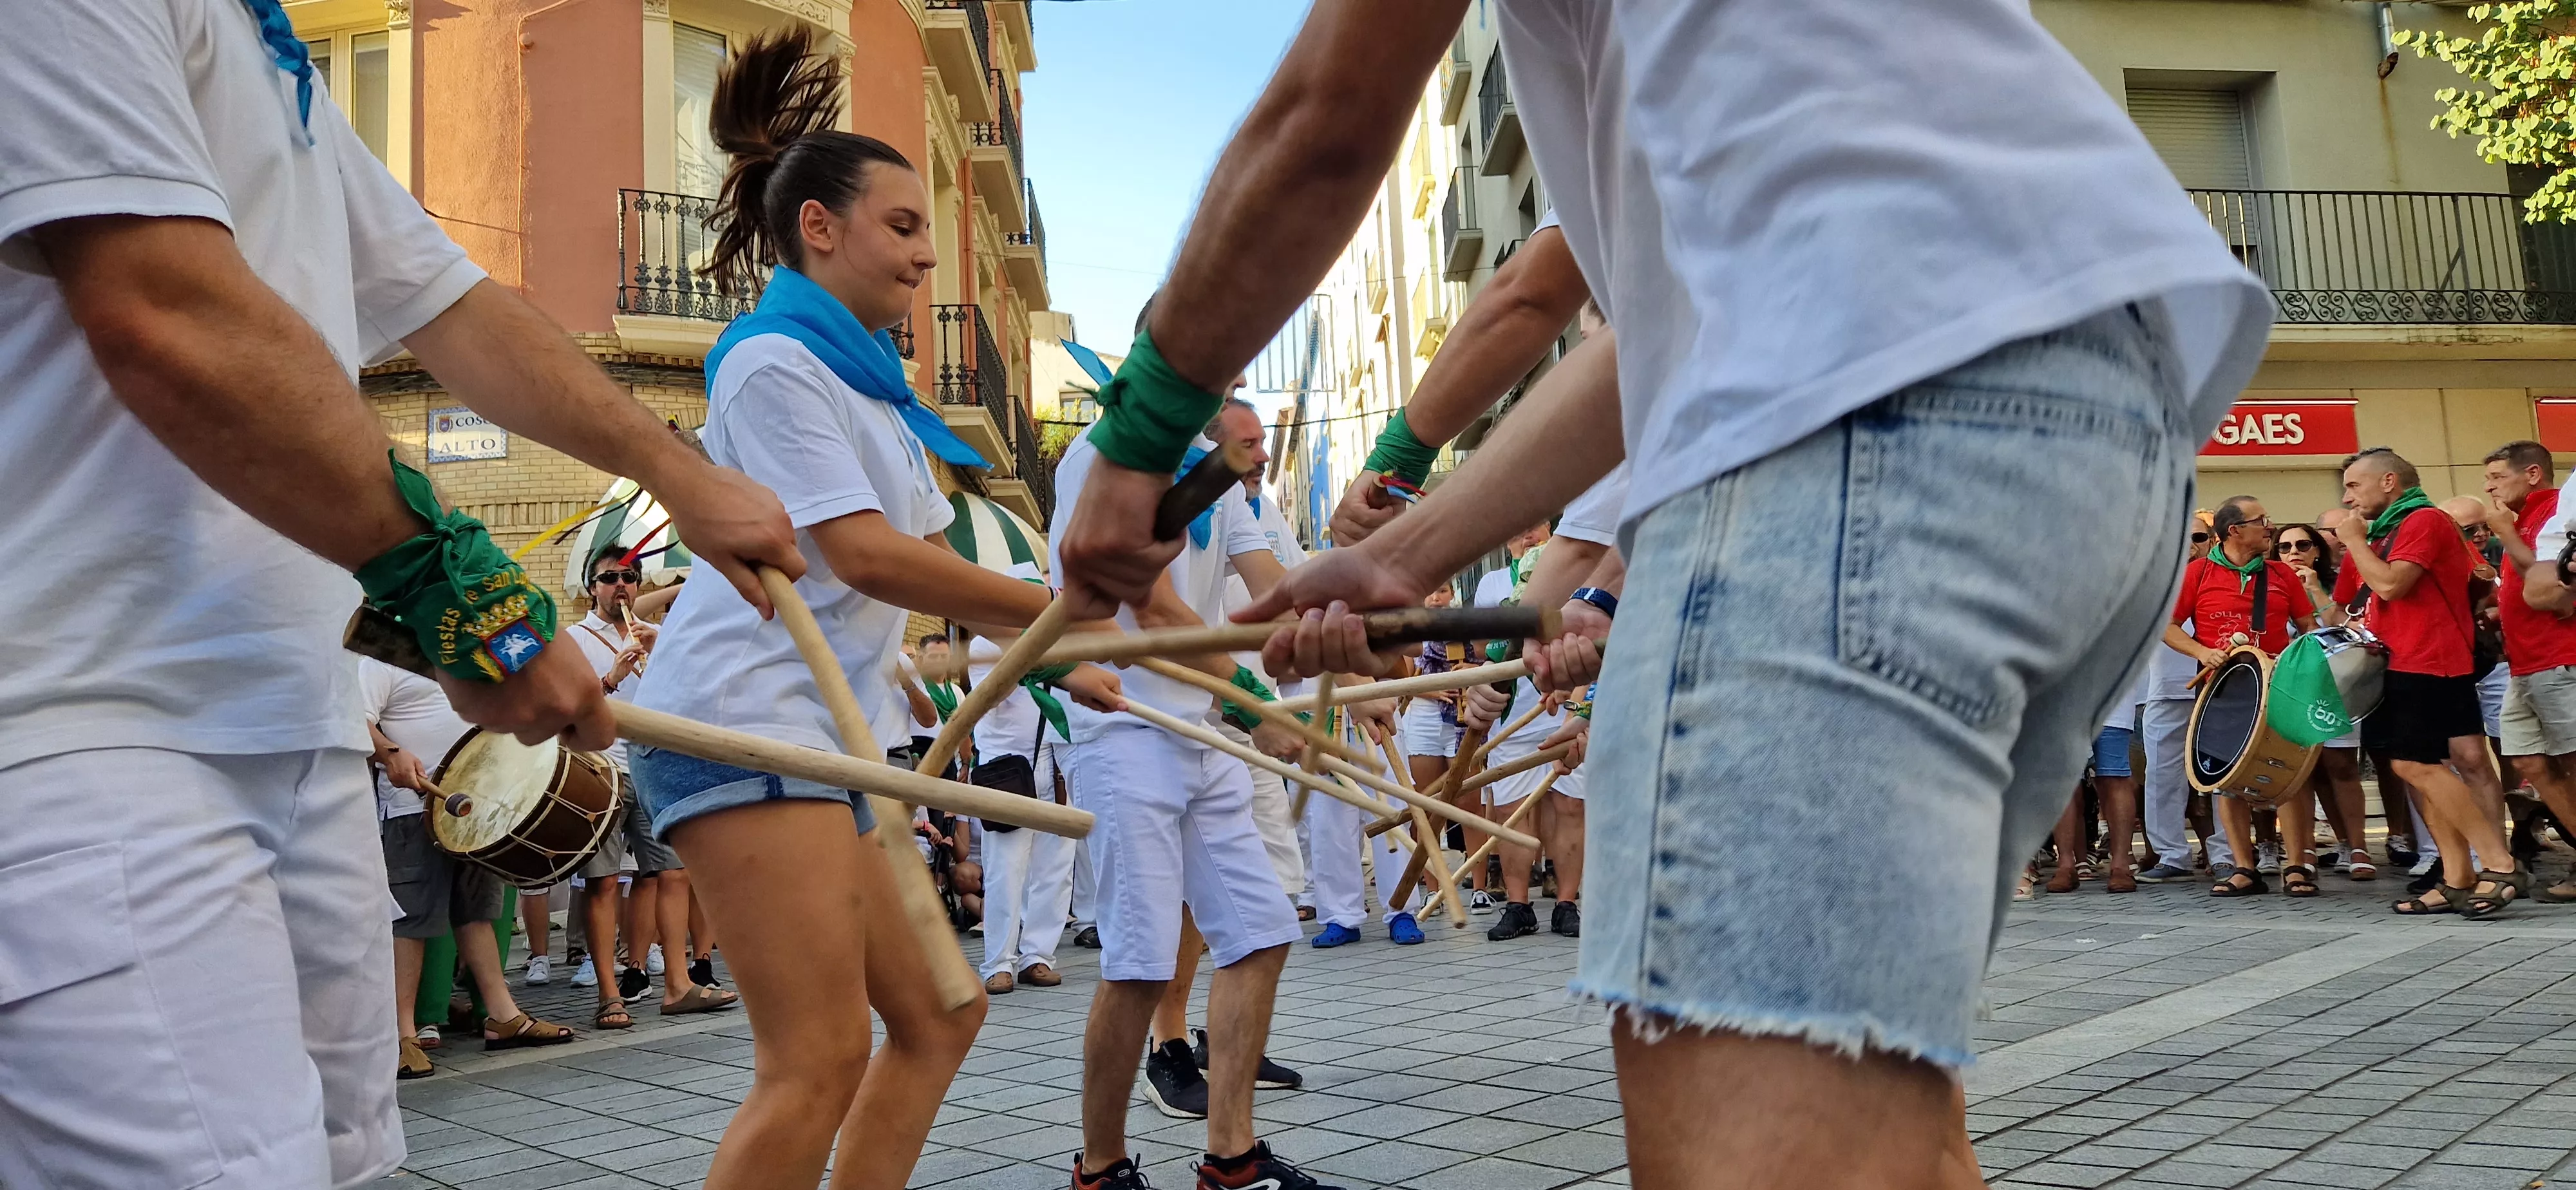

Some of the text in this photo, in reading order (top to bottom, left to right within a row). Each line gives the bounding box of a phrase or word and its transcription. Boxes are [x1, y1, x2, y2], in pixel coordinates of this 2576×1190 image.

[2211, 413, 2304, 445] GAES
[439, 439, 496, 454] ALTO
[2210, 611, 2242, 620] COLLA
